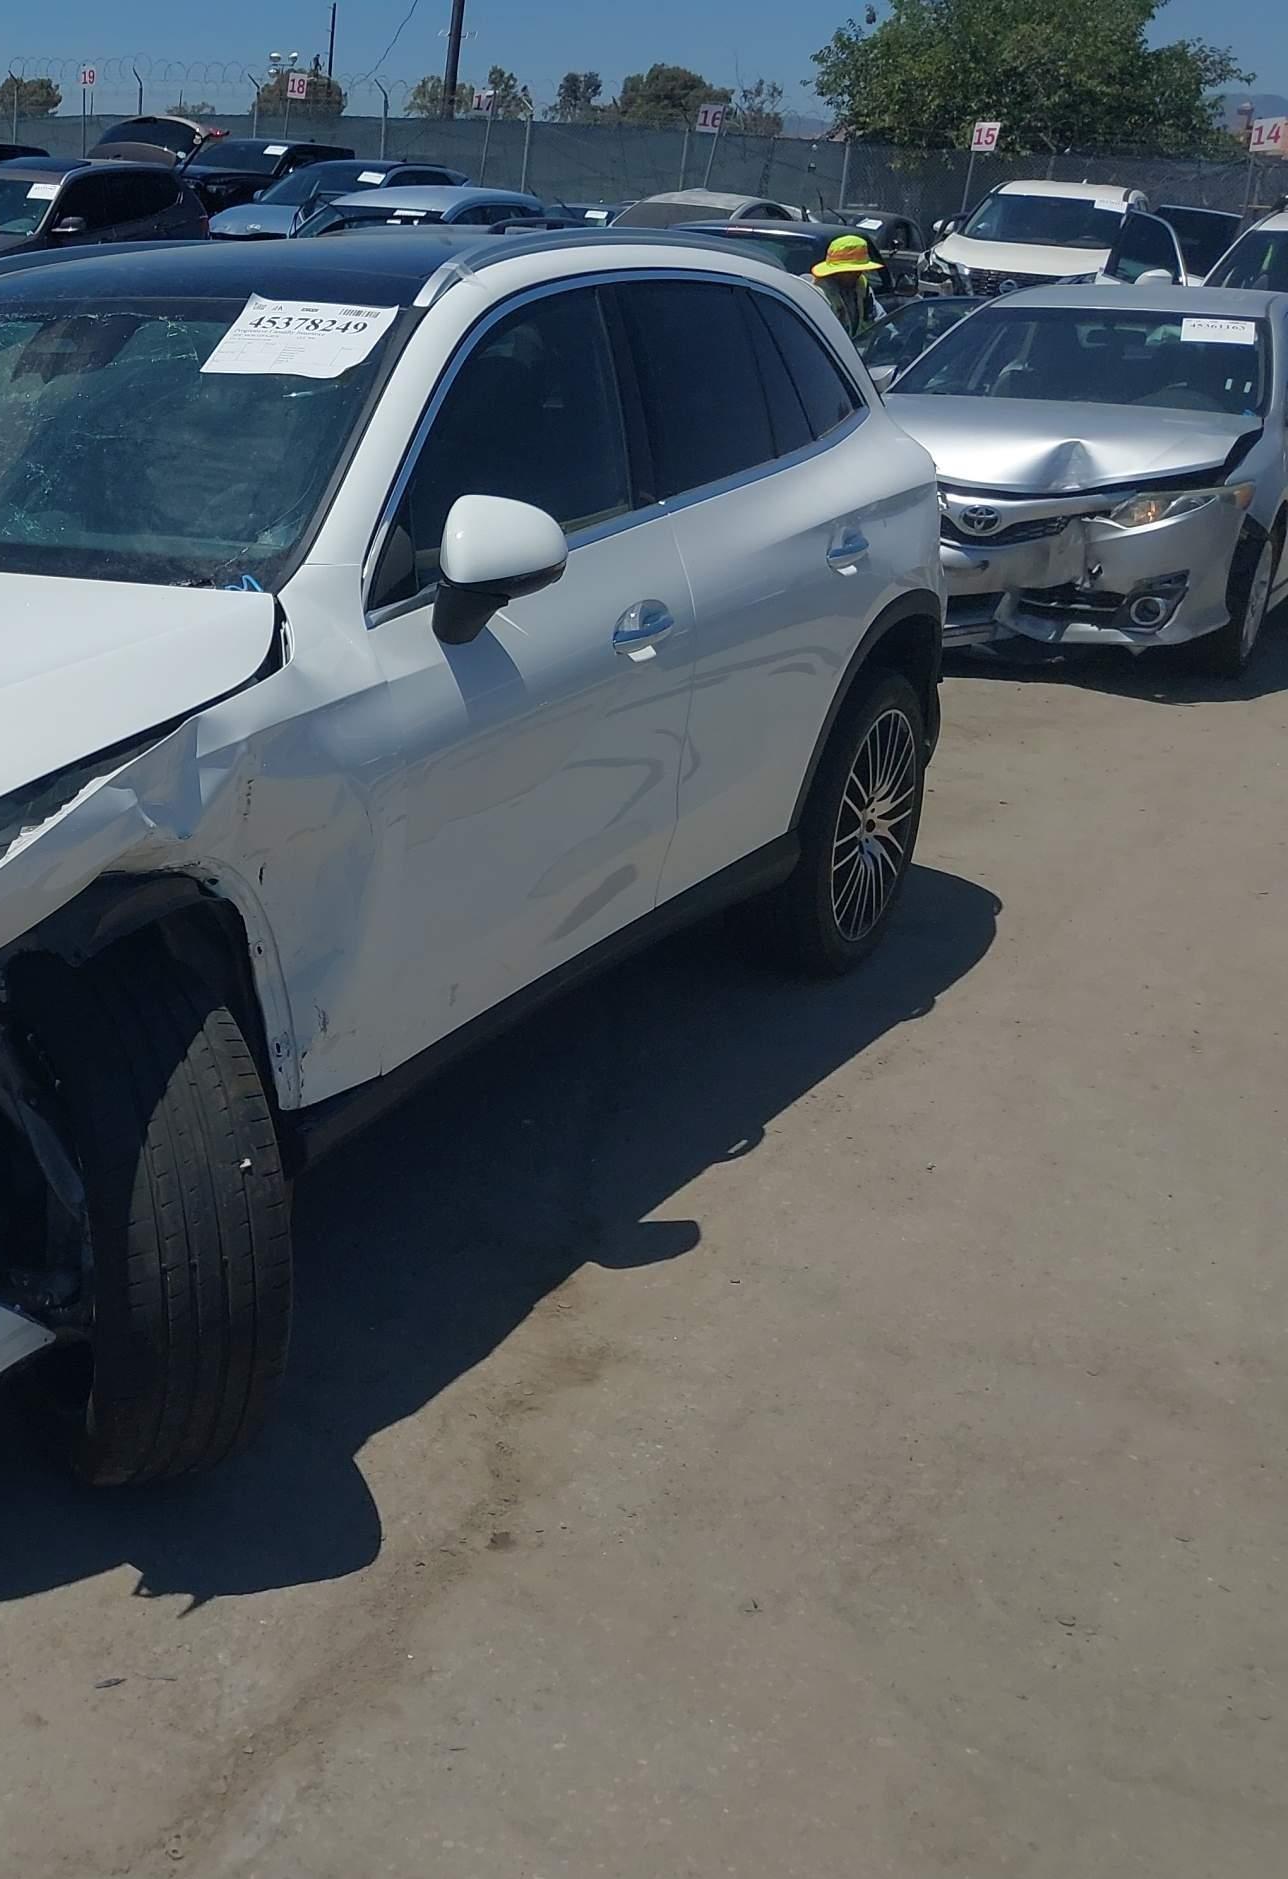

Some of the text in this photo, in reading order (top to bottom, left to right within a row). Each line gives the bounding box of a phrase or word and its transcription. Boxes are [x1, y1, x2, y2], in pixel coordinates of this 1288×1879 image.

[81, 69, 96, 85] 19
[288, 78, 306, 94] 18
[473, 94, 494, 112] 17
[698, 109, 722, 128] 16
[973, 127, 998, 146] 15
[1252, 122, 1281, 146] 14
[248, 315, 369, 334] 45378249
